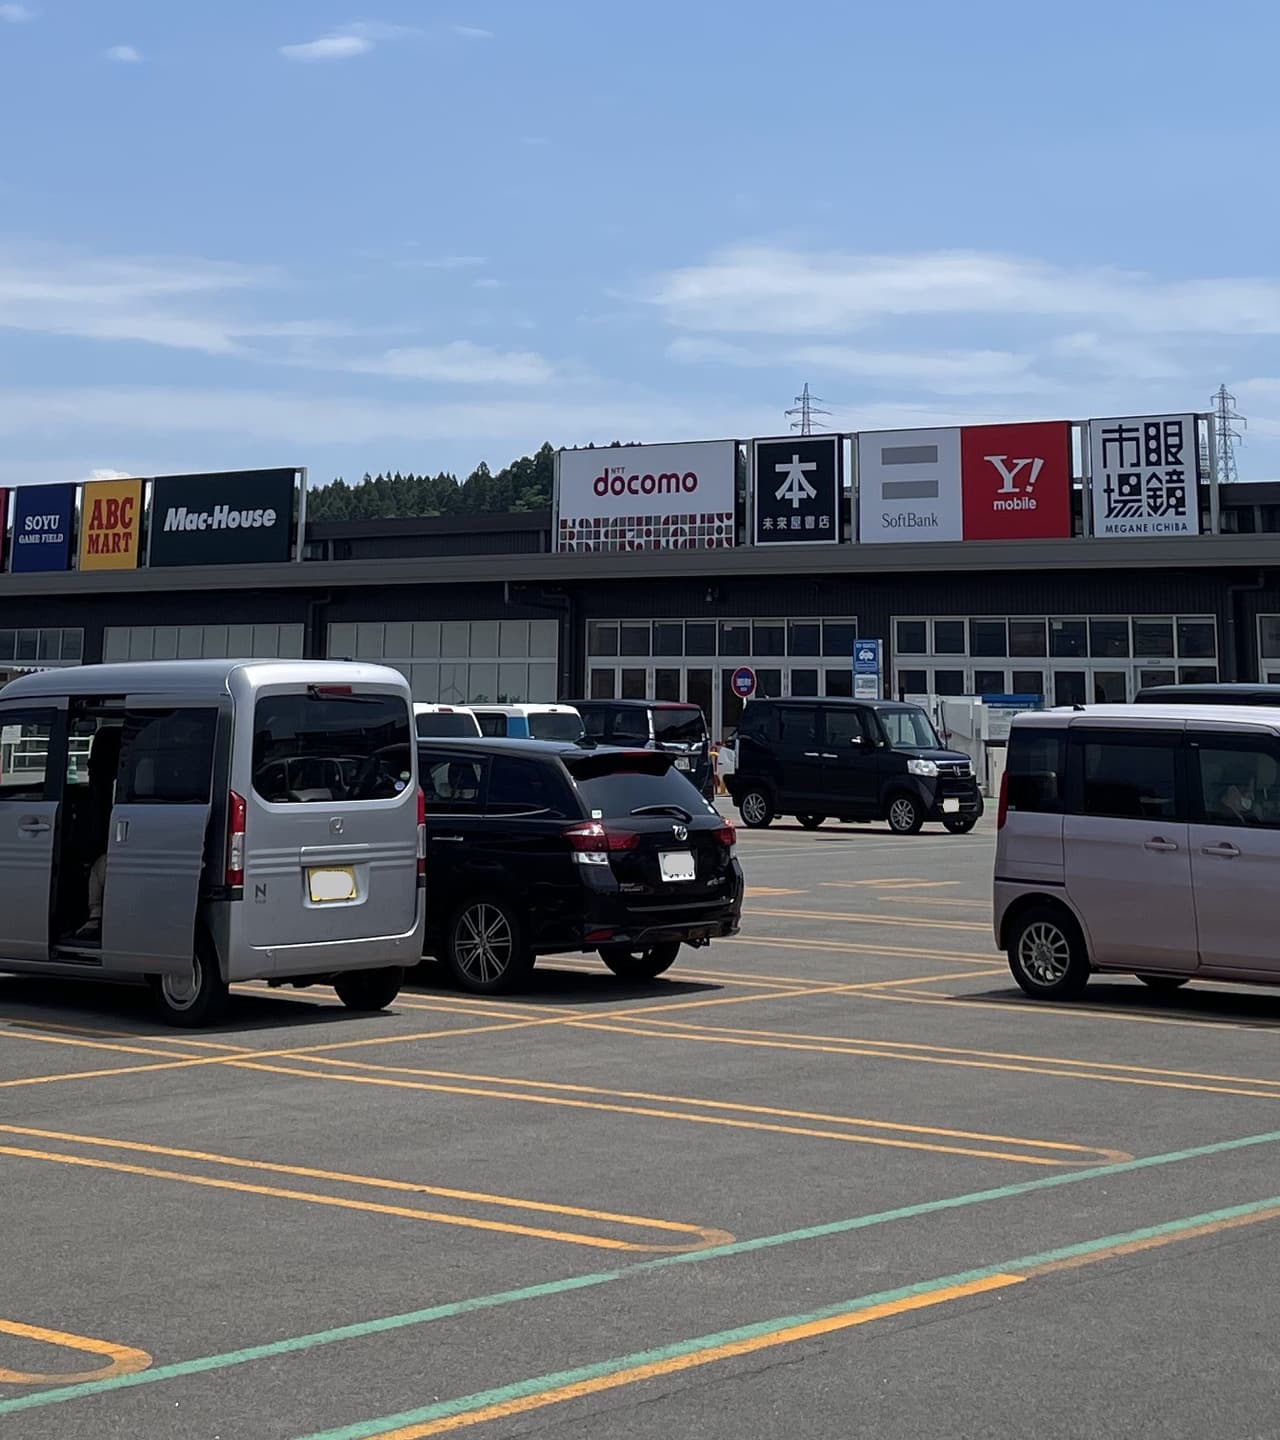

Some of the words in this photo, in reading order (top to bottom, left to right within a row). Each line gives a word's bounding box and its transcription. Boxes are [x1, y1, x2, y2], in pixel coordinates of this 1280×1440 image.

[593, 468, 698, 497] docomo
[775, 454, 817, 509] 本
[993, 497, 1037, 511] mobile
[89, 497, 134, 530] ABC
[882, 513, 939, 528] SoftBank
[25, 515, 60, 531] SOYU
[762, 516, 830, 530] 未来屋書店
[1105, 524, 1148, 533] MEGANE
[1152, 523, 1188, 532] ICHIBA
[18, 534, 41, 544] GAME
[41, 533, 64, 543] FIELD
[87, 532, 132, 555] MART
